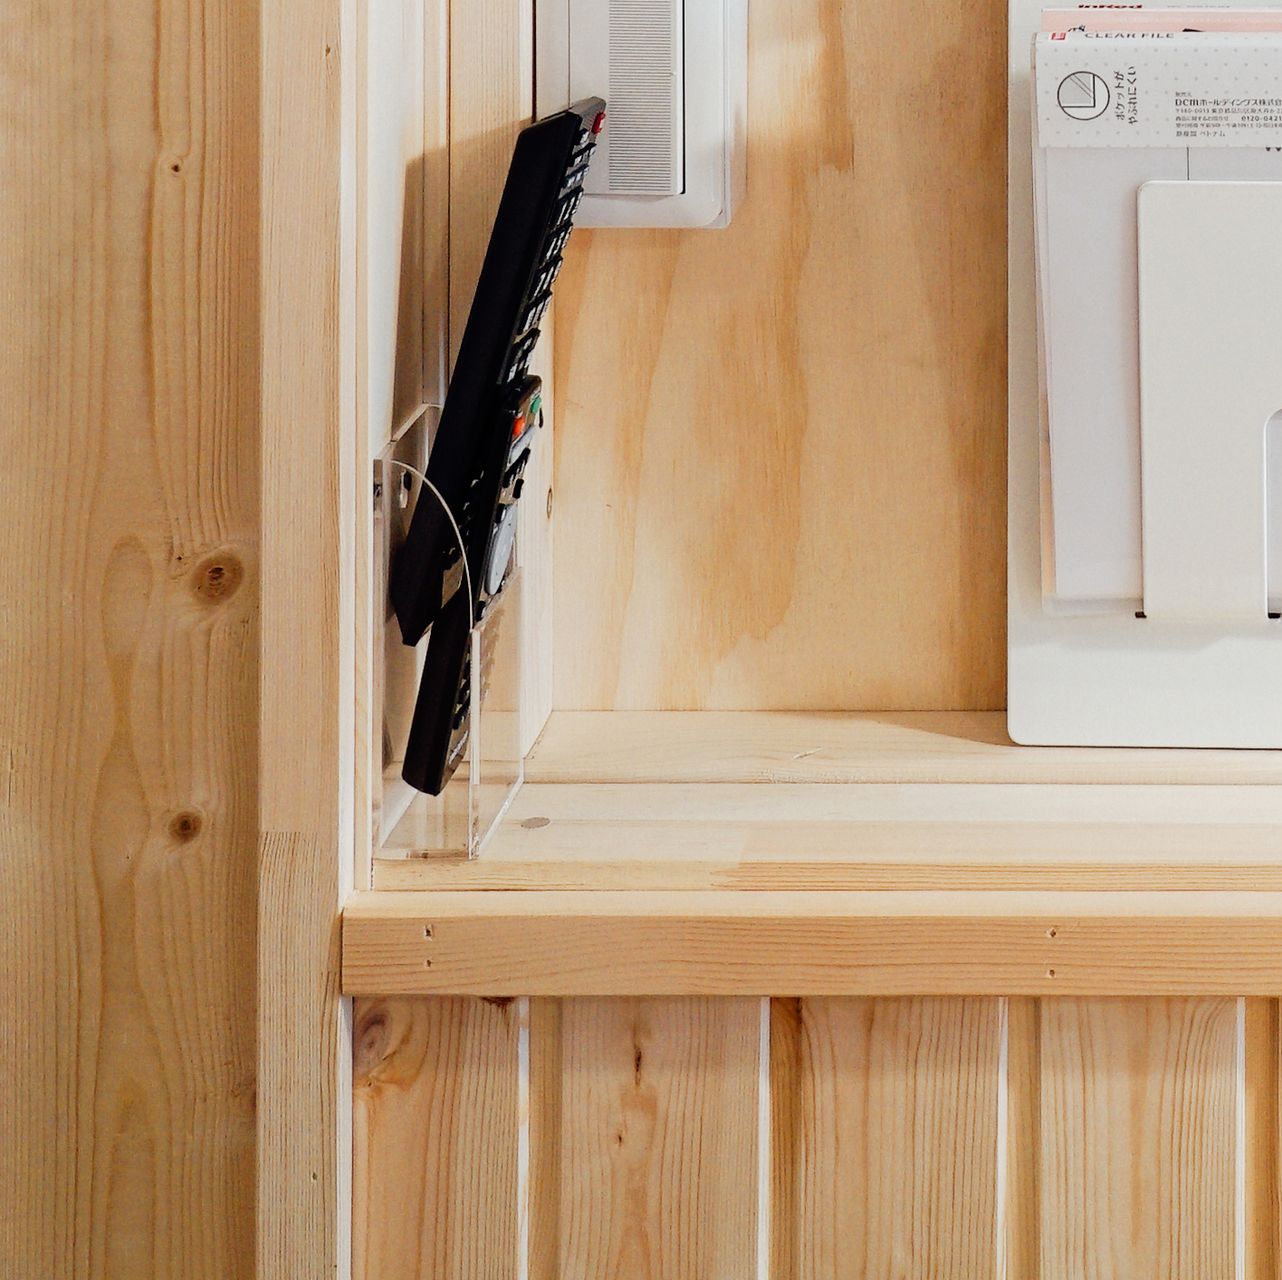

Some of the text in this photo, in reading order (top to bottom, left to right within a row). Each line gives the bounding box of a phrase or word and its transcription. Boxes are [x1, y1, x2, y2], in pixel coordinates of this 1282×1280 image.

[1113, 70, 1126, 121] ポケットが
[1126, 65, 1139, 126] やぶれにくい
